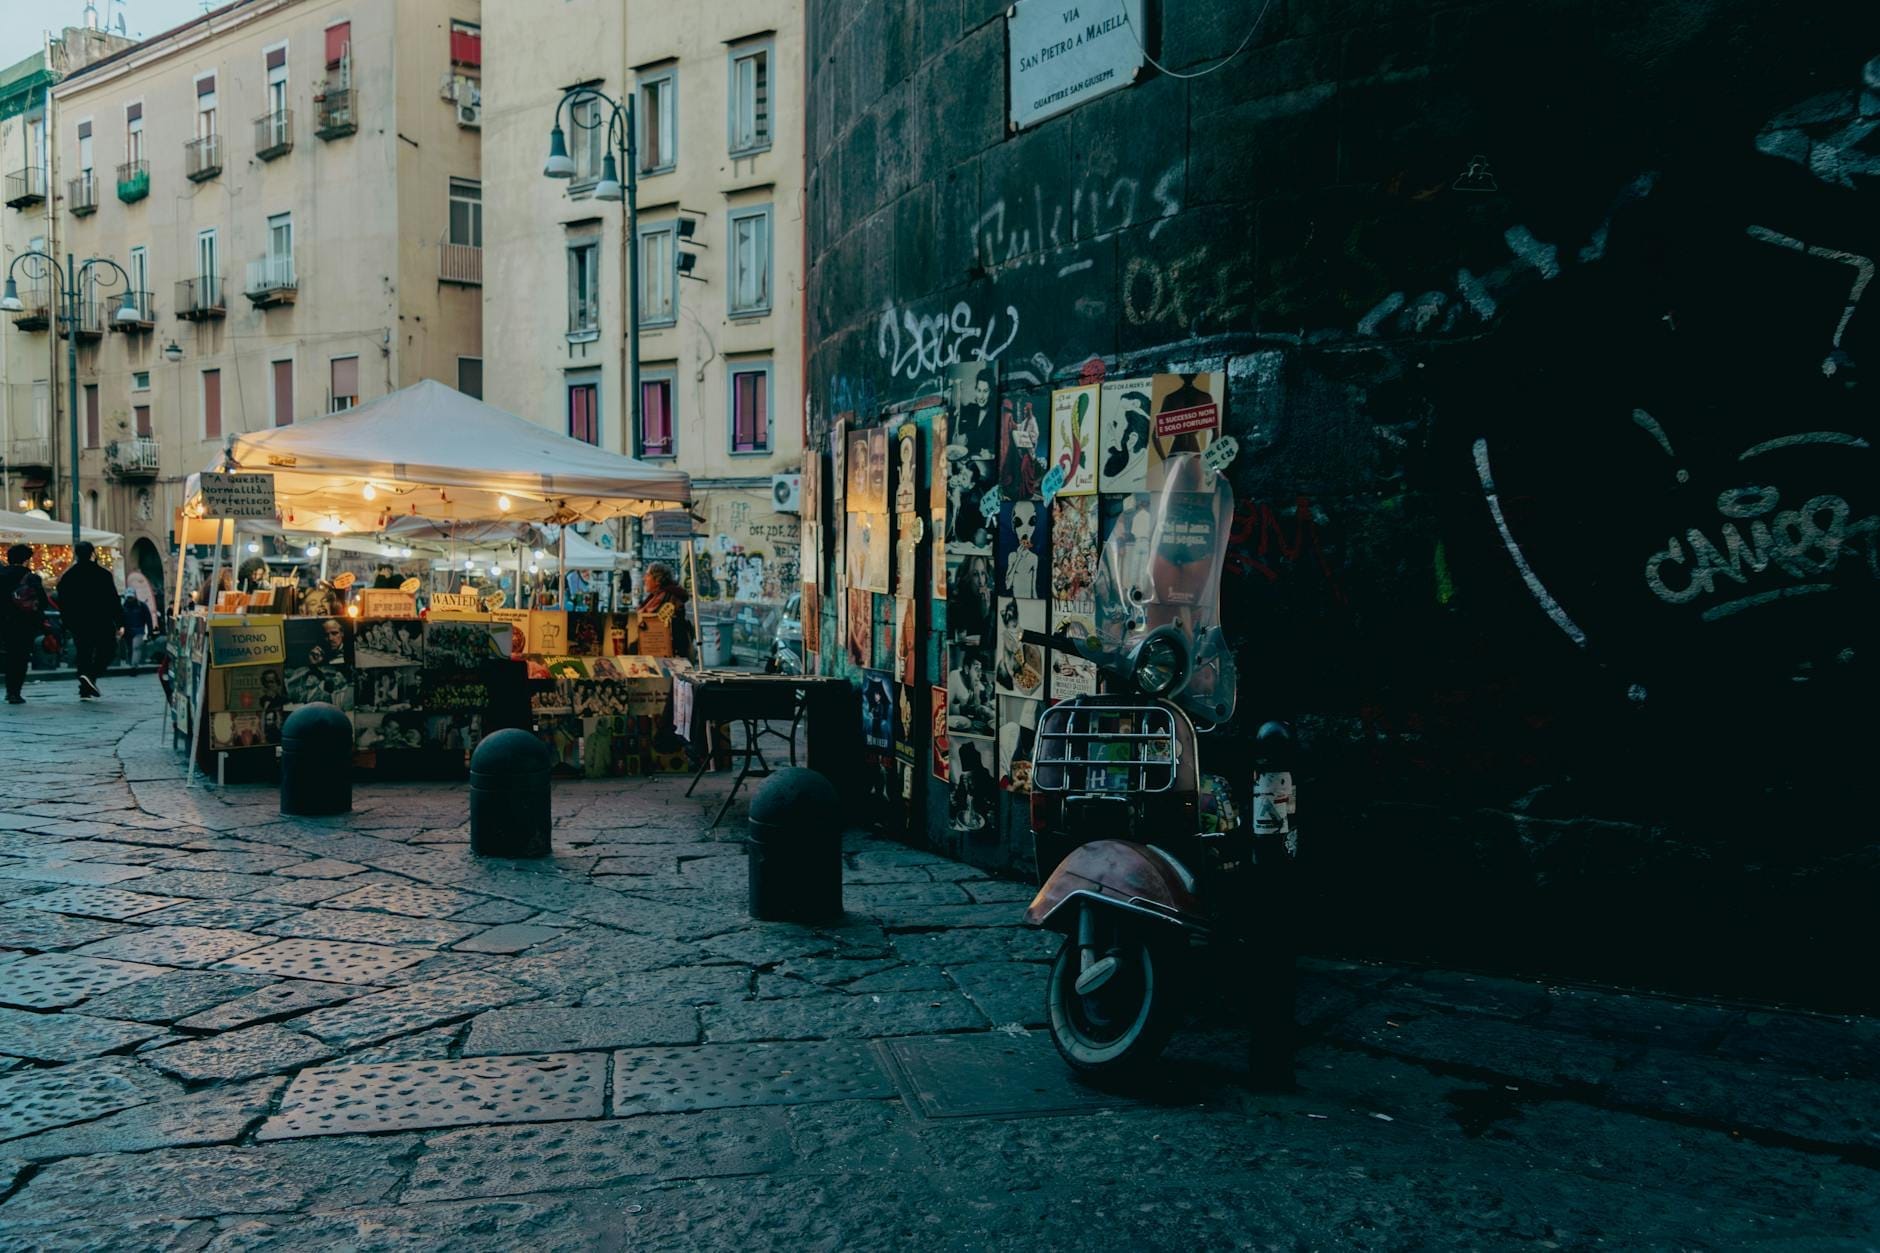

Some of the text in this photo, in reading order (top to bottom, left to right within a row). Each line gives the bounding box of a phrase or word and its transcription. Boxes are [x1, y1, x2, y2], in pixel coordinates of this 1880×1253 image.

[1063, 8, 1080, 24] VIA
[1041, 38, 1074, 63] PIETRO
[1076, 33, 1083, 47] A
[1086, 12, 1129, 42] MAIELLA
[1033, 68, 1115, 110] QUARTIERE SAN GIUSEPPE
[1165, 411, 1198, 424] SUCCESSO
[1198, 408, 1215, 418] NON
[1164, 422, 1182, 432] SOLO
[1182, 417, 1216, 429] FORTUNA!
[432, 594, 477, 606] WANTED
[232, 634, 267, 644] TORNO
[253, 646, 262, 656] O
